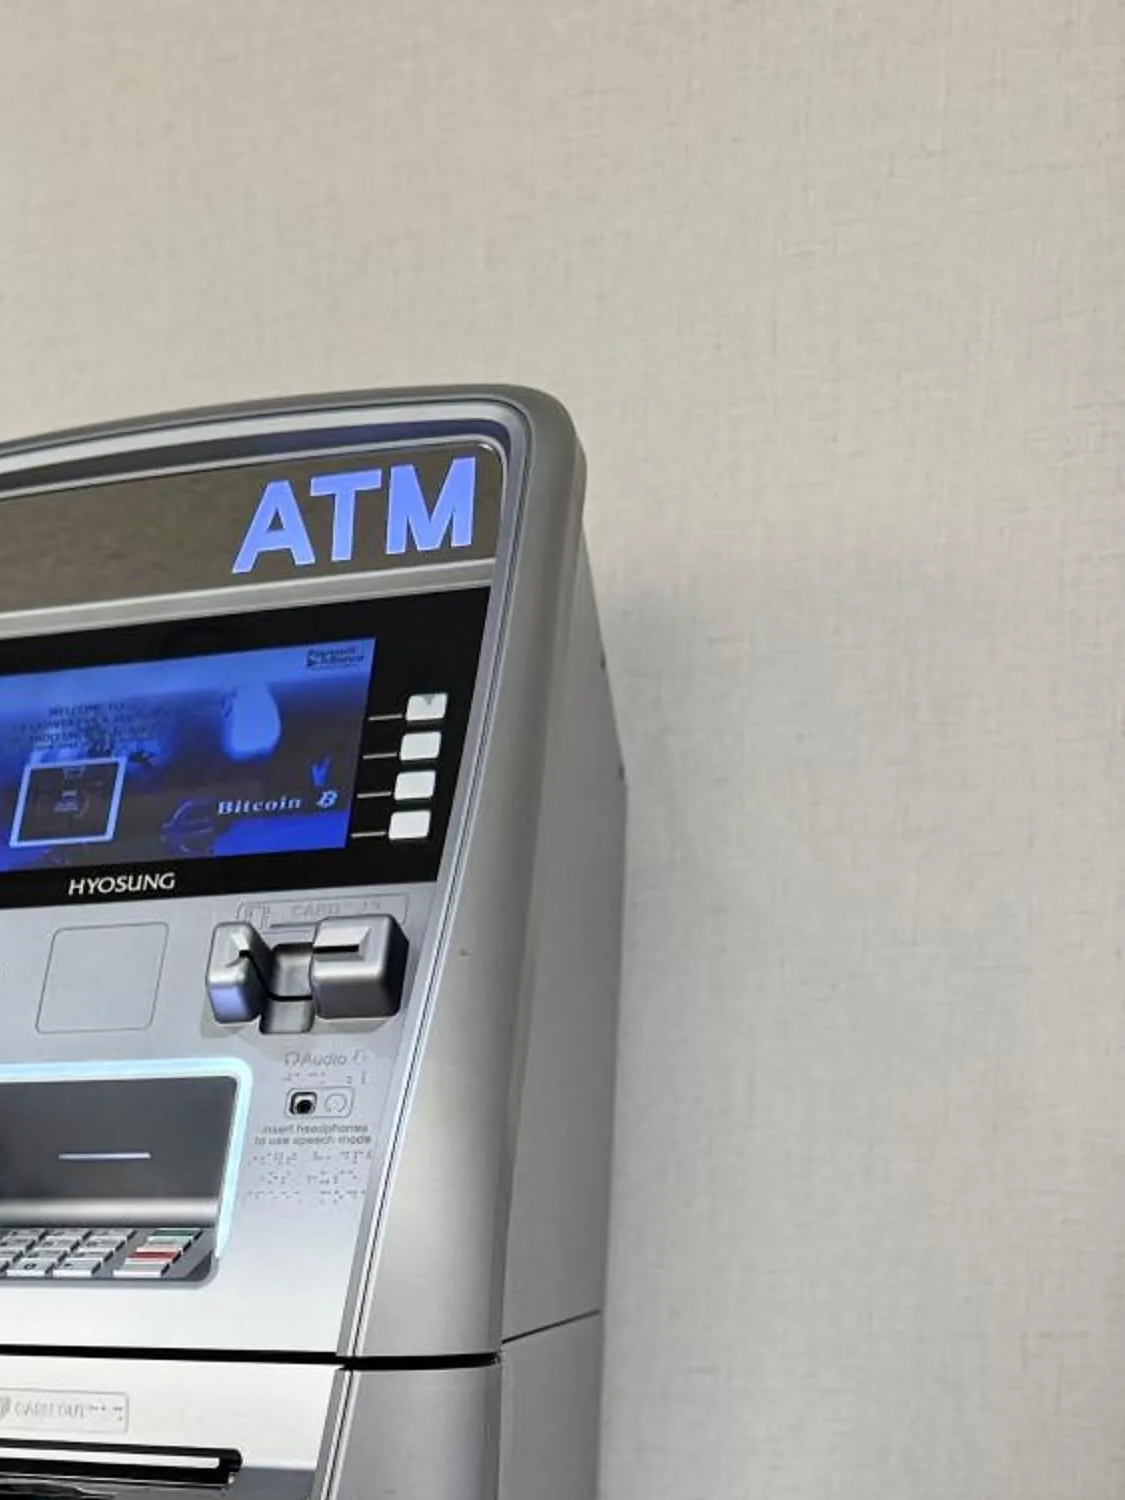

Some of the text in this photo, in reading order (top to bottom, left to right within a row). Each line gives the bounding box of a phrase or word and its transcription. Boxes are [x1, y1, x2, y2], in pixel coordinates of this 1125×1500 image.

[232, 456, 476, 574] ATM
[218, 795, 301, 815] Bitcoin
[68, 871, 175, 896] HYOSUNG
[300, 1053, 348, 1067] Audio
